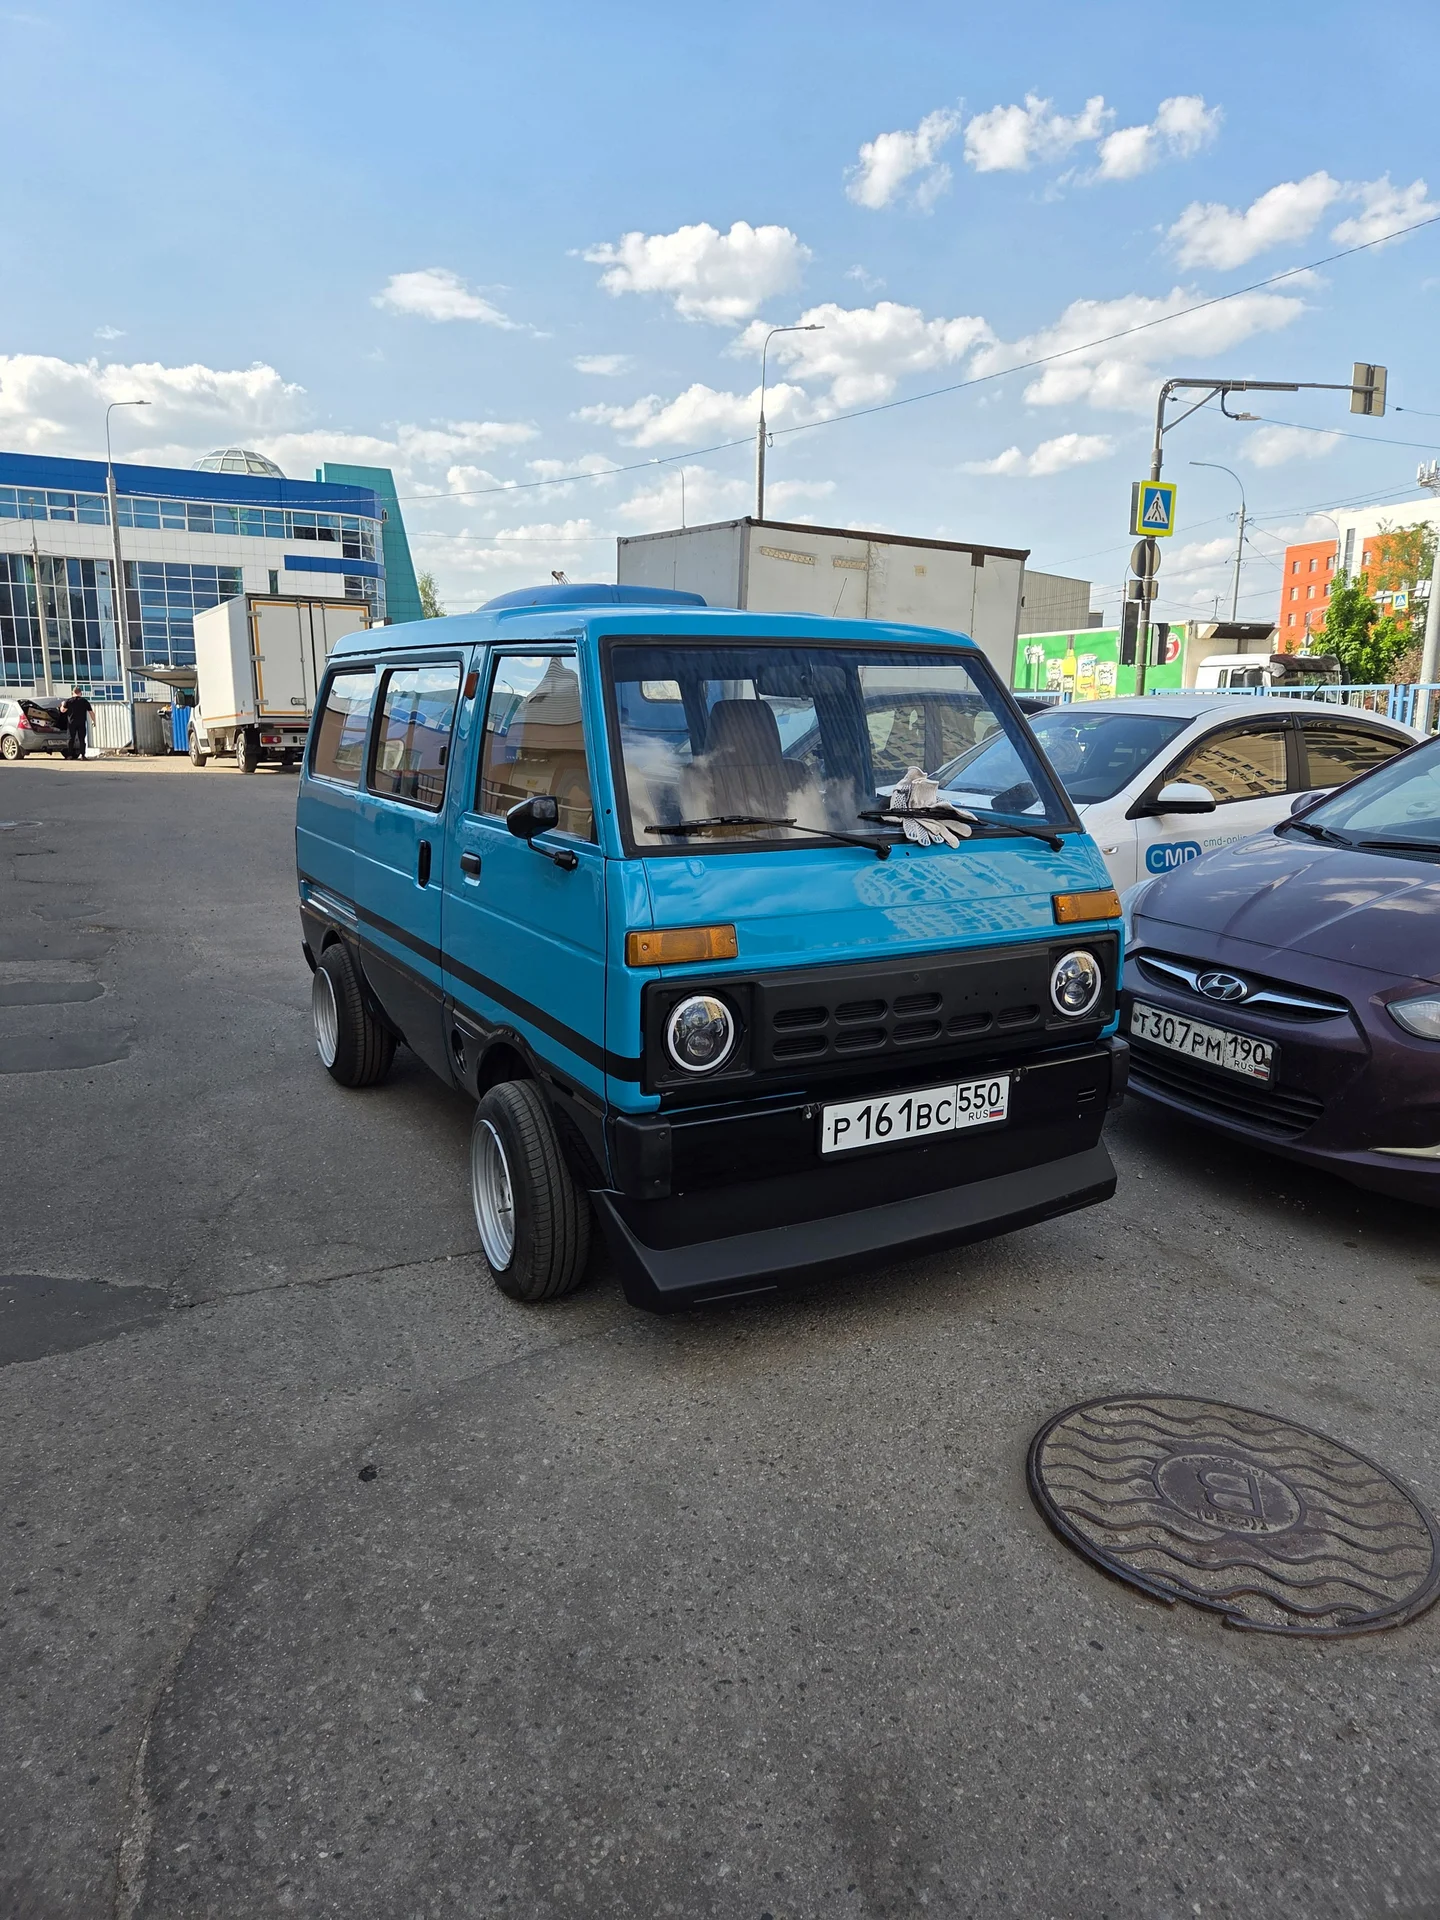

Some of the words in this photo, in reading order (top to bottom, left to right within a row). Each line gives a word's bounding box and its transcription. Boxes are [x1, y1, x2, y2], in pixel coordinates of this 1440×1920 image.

[1151, 847, 1198, 867] CMD
[1228, 1036, 1266, 1065] 190
[1234, 1059, 1254, 1073] RUS
[958, 1082, 1000, 1112] 550
[968, 1110, 989, 1122] RUS
